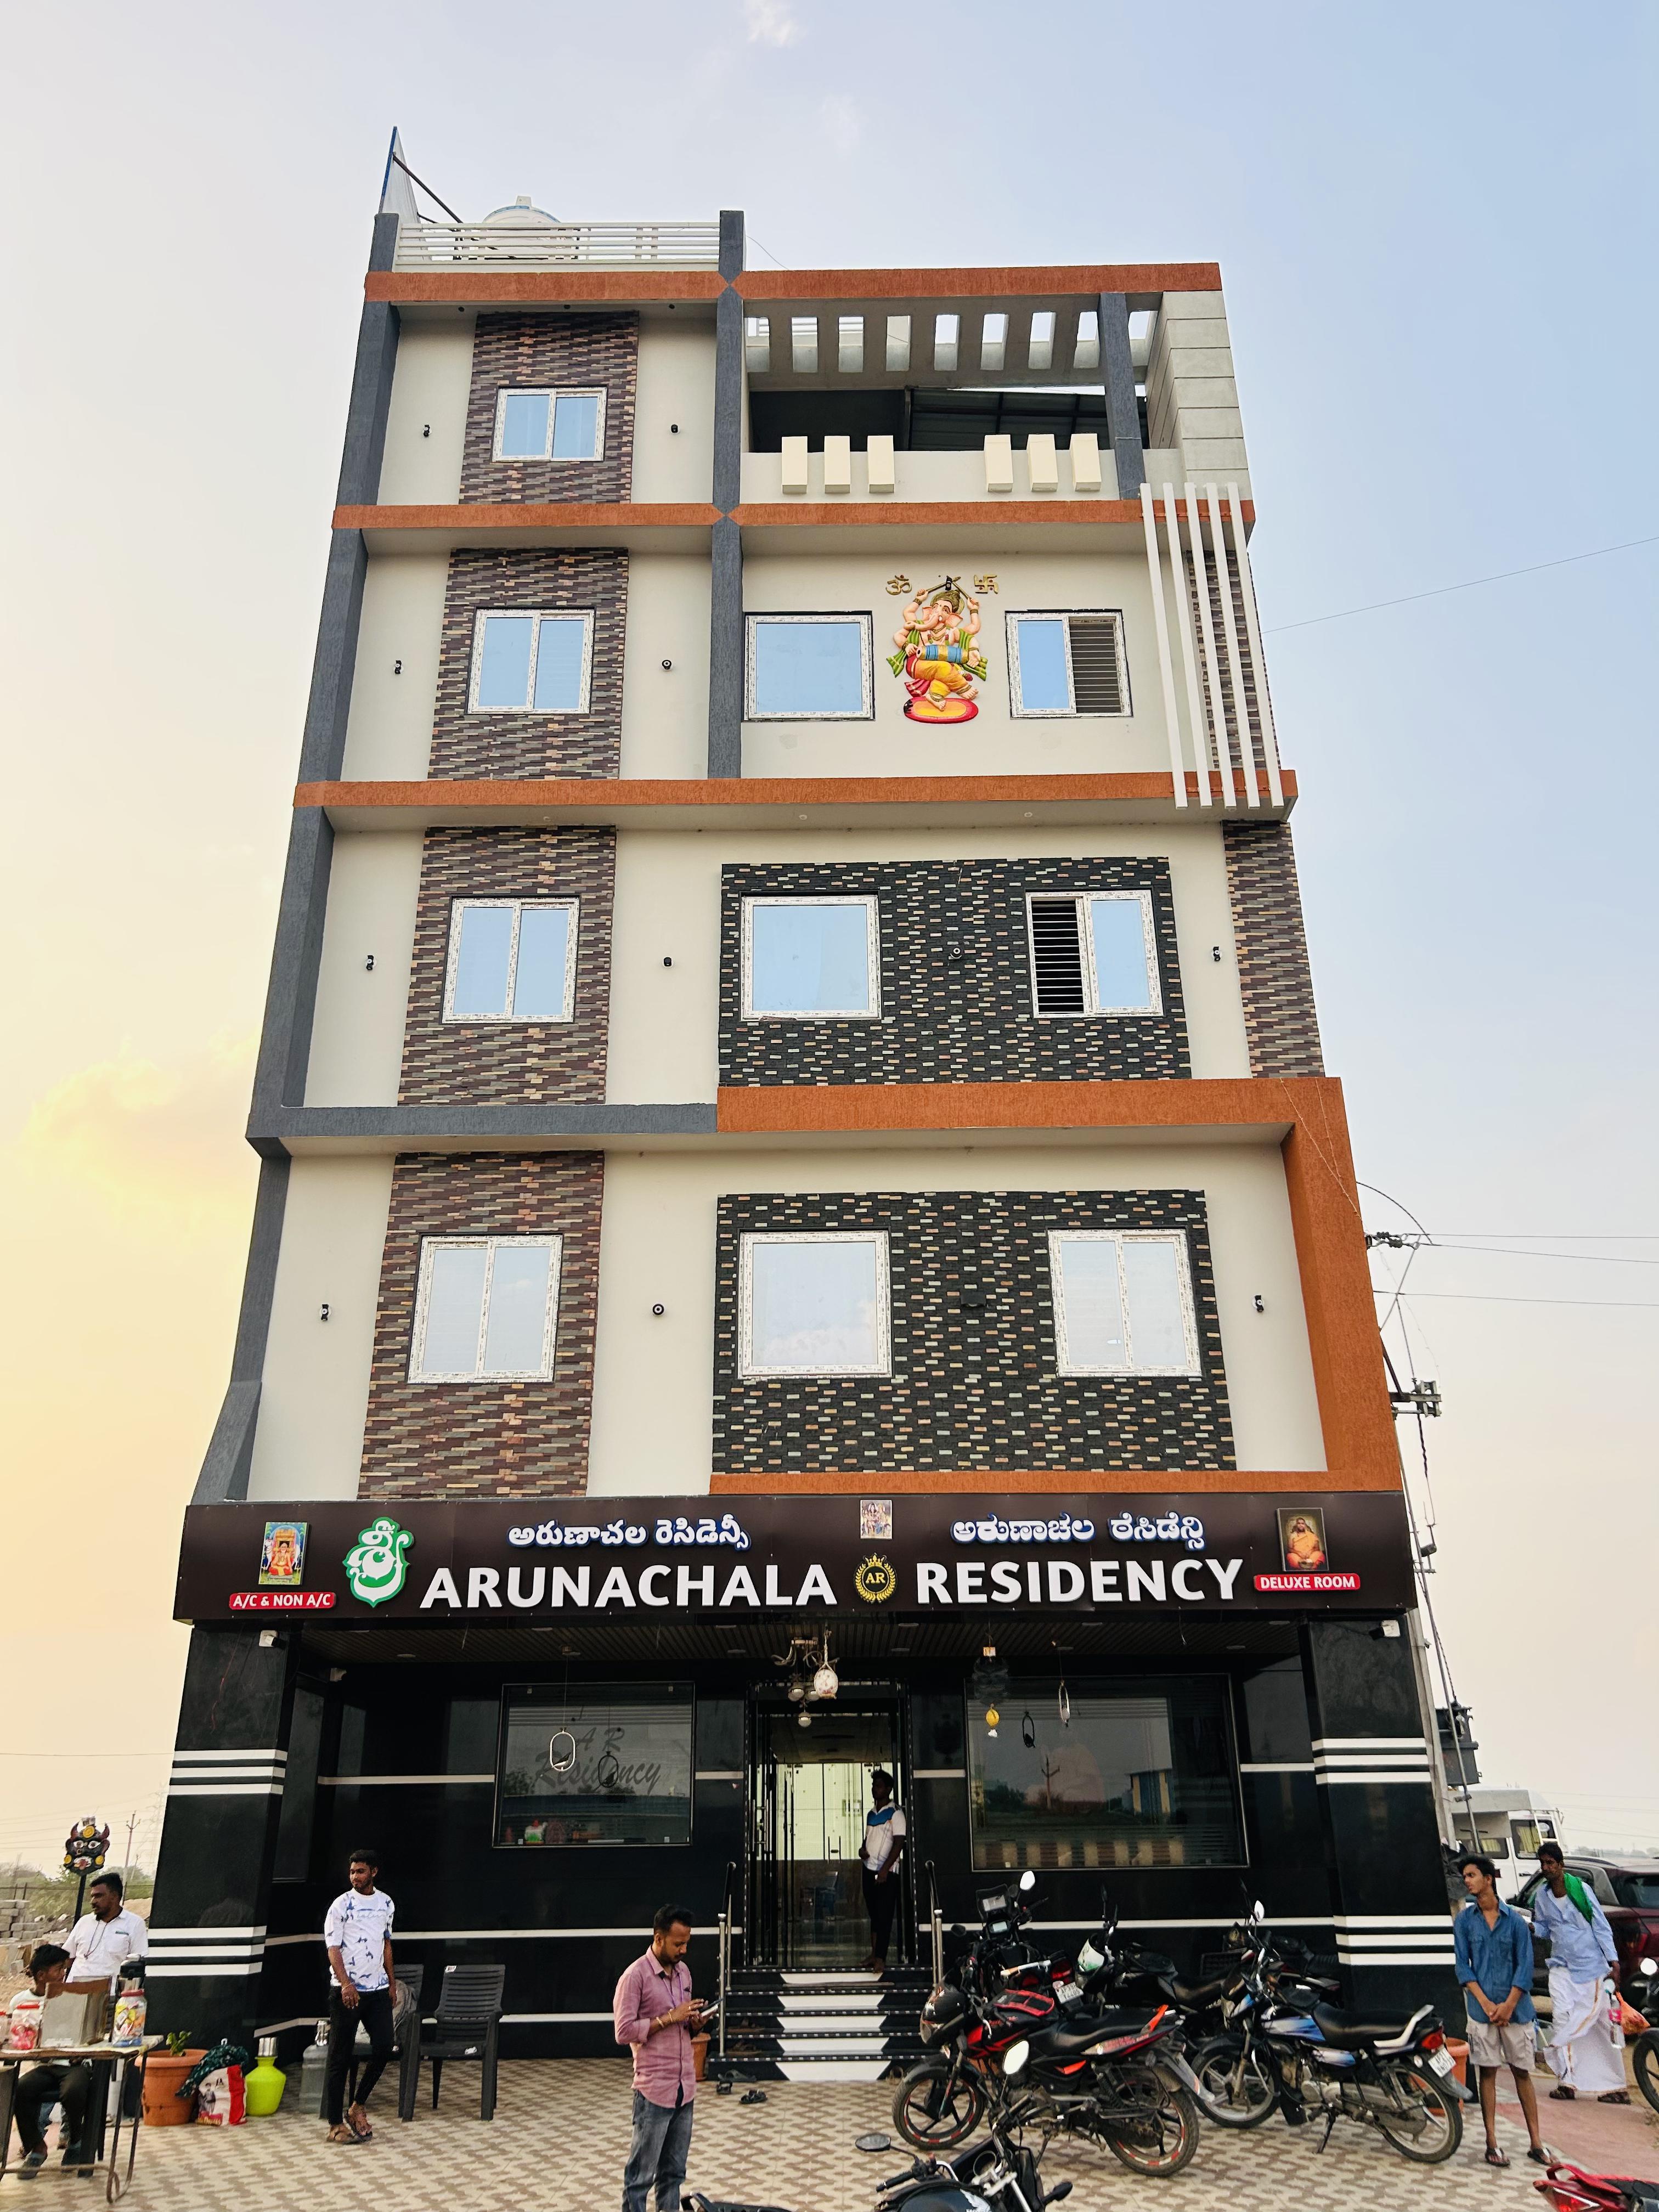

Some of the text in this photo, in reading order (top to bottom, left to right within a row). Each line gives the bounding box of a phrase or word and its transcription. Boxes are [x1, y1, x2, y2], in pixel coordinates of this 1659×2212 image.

[509, 1519, 647, 1545] అరుణాచల
[953, 1513, 1095, 1542] ಅರುಣಾಚಲ
[419, 1559, 1243, 1609] ARUNACHALA RESIDENCY
[865, 1572, 886, 1584] AR
[1260, 1576, 1356, 1589] DELUXE ROOM
[233, 1593, 331, 1609] A/C & NON A/C
